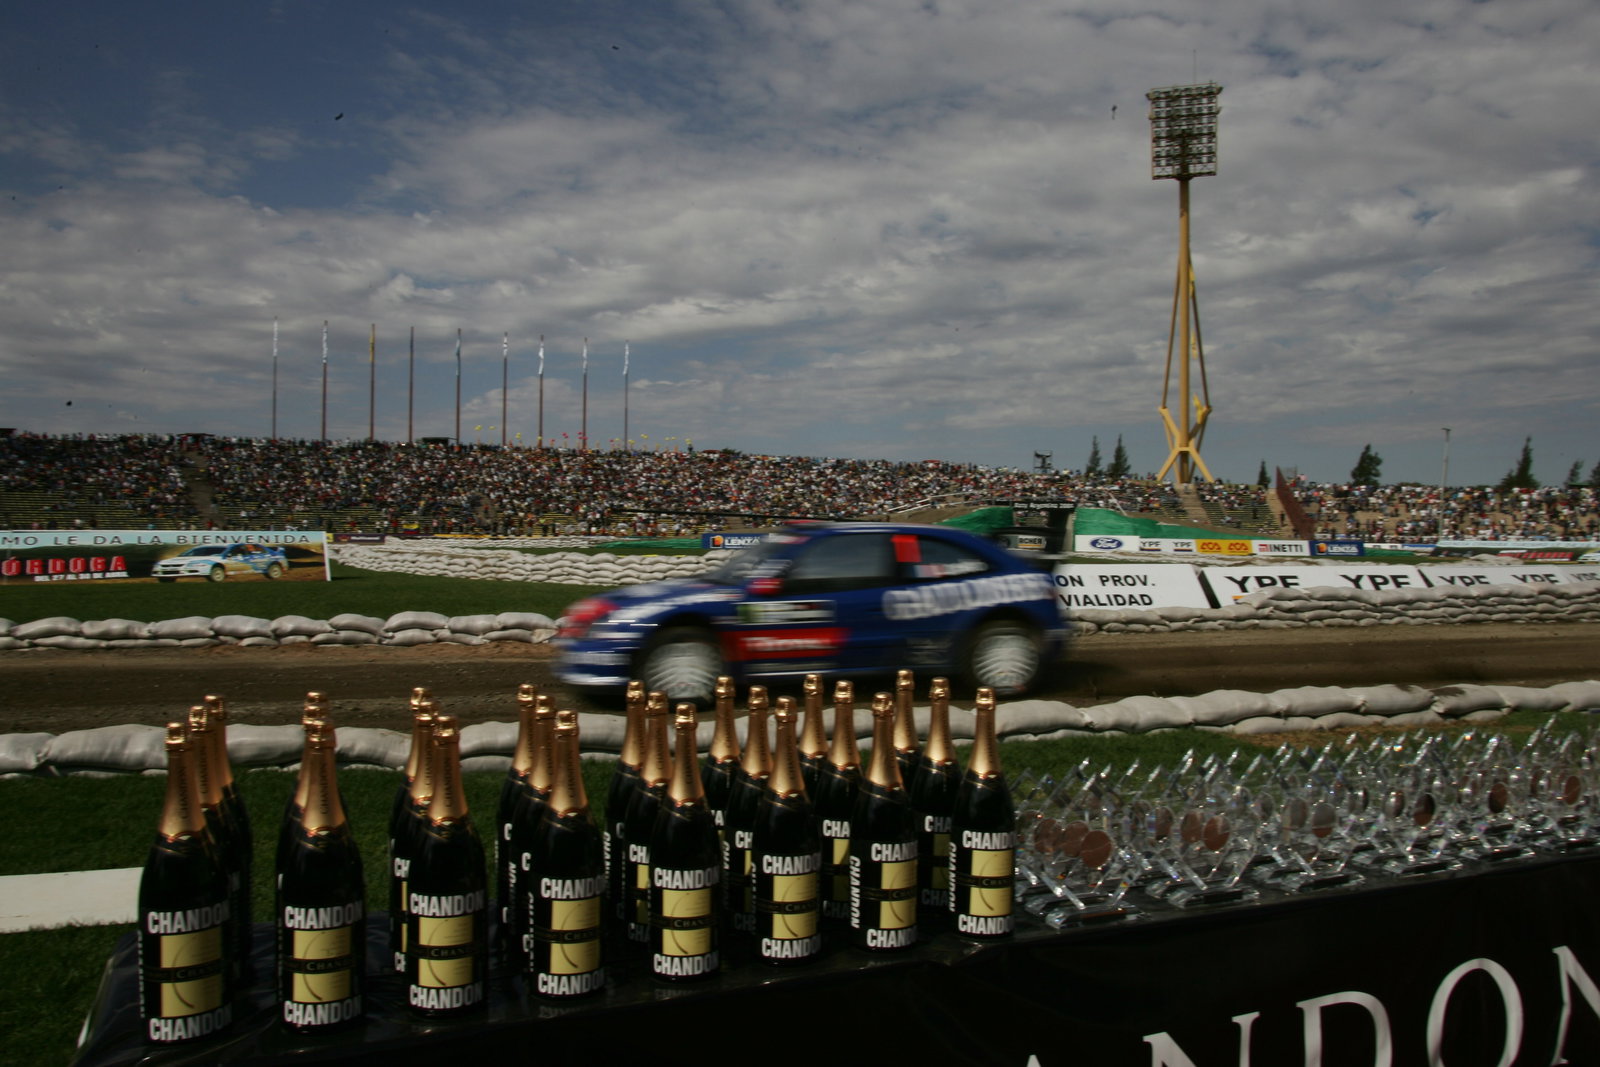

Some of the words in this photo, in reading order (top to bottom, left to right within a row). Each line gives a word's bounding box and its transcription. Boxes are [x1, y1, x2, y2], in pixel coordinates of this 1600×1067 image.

[1, 536, 38, 546] MO
[54, 536, 79, 546] LE
[94, 535, 123, 545] DA
[137, 535, 162, 545] LA
[177, 535, 310, 544] BIENVENIDA
[1099, 575, 1155, 586] PROV.
[1339, 574, 1410, 591] YPF
[1059, 594, 1153, 606] VIALIDAD
[410, 889, 485, 917] CHANDON
[850, 855, 862, 930] CHANDON
[147, 901, 230, 934] CHANDON
[284, 901, 363, 931] CHANDON
[409, 981, 483, 1009] CHANDON
[150, 1001, 232, 1042] CHANDON
[283, 994, 362, 1025] CHANDON
